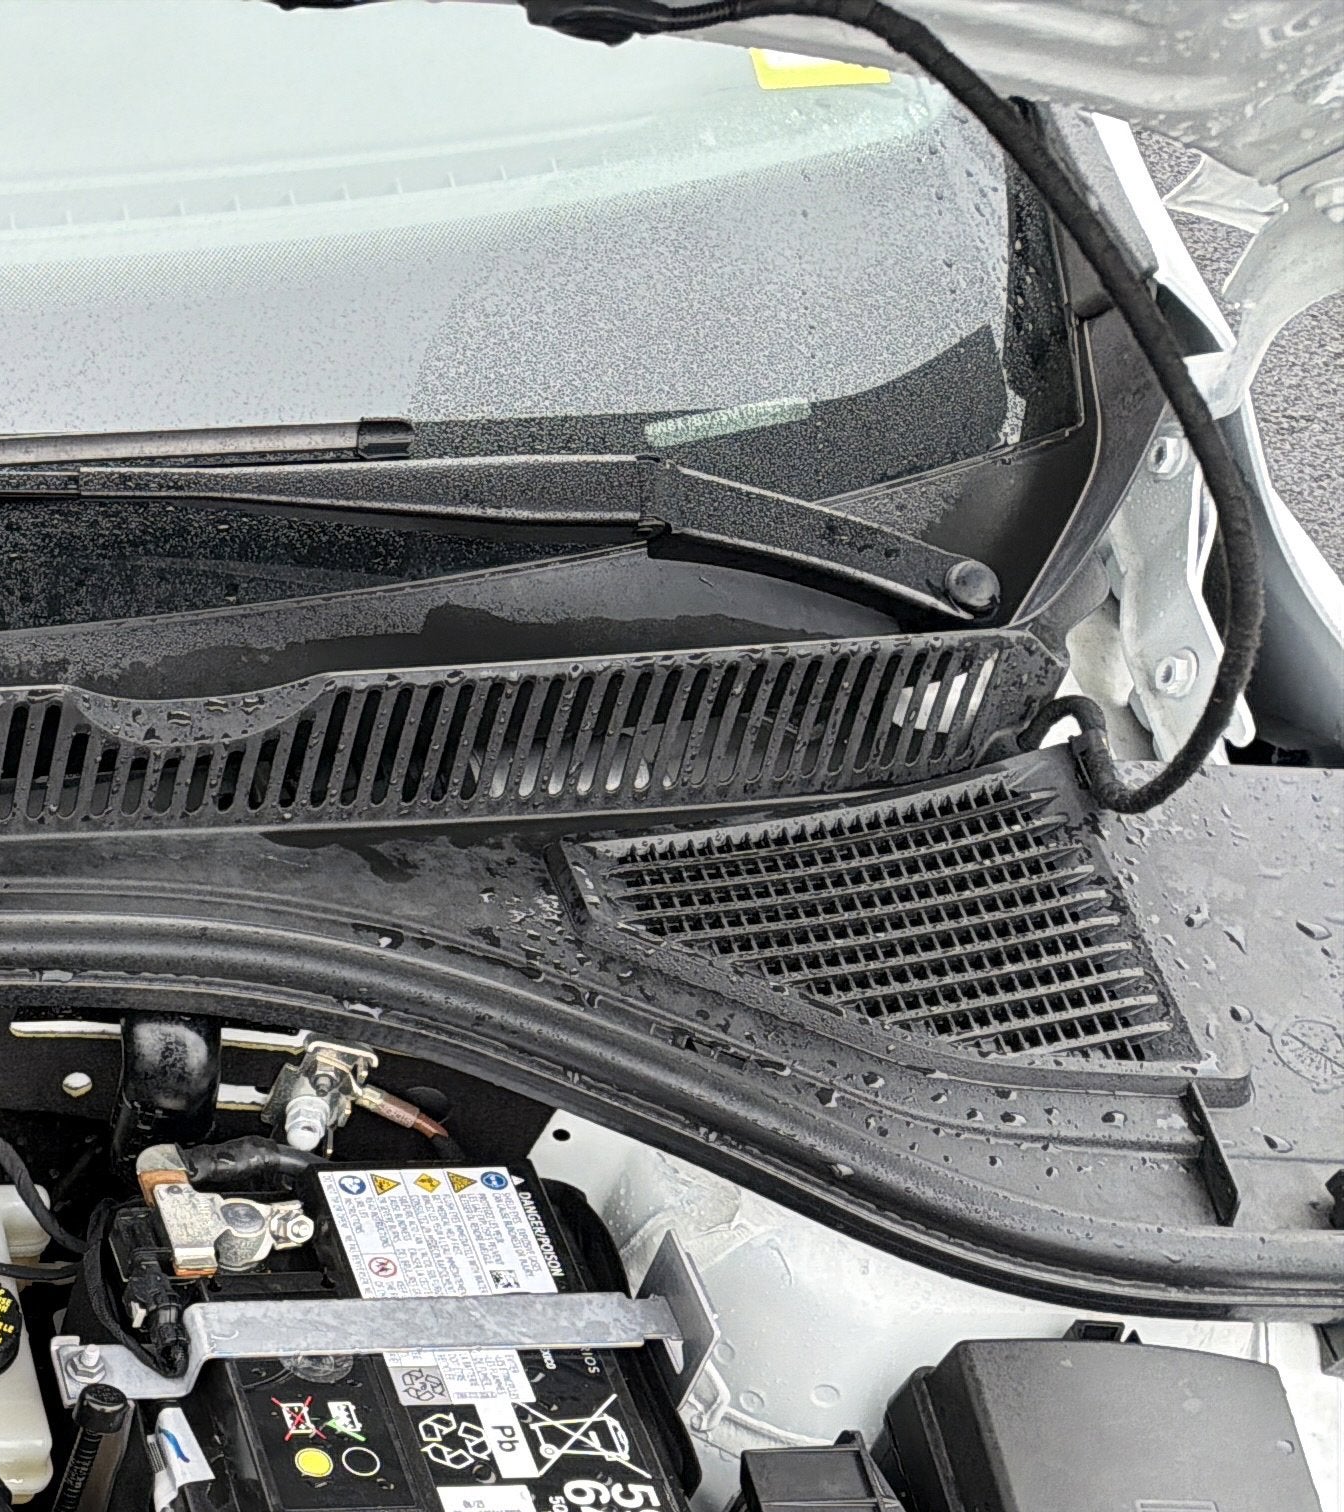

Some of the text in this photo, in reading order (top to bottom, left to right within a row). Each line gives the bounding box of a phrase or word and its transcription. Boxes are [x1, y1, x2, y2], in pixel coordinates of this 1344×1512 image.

[518, 1191, 565, 1277] DANGER/POISON
[2, 1323, 14, 1333] LE
[491, 1424, 520, 1453] Pb
